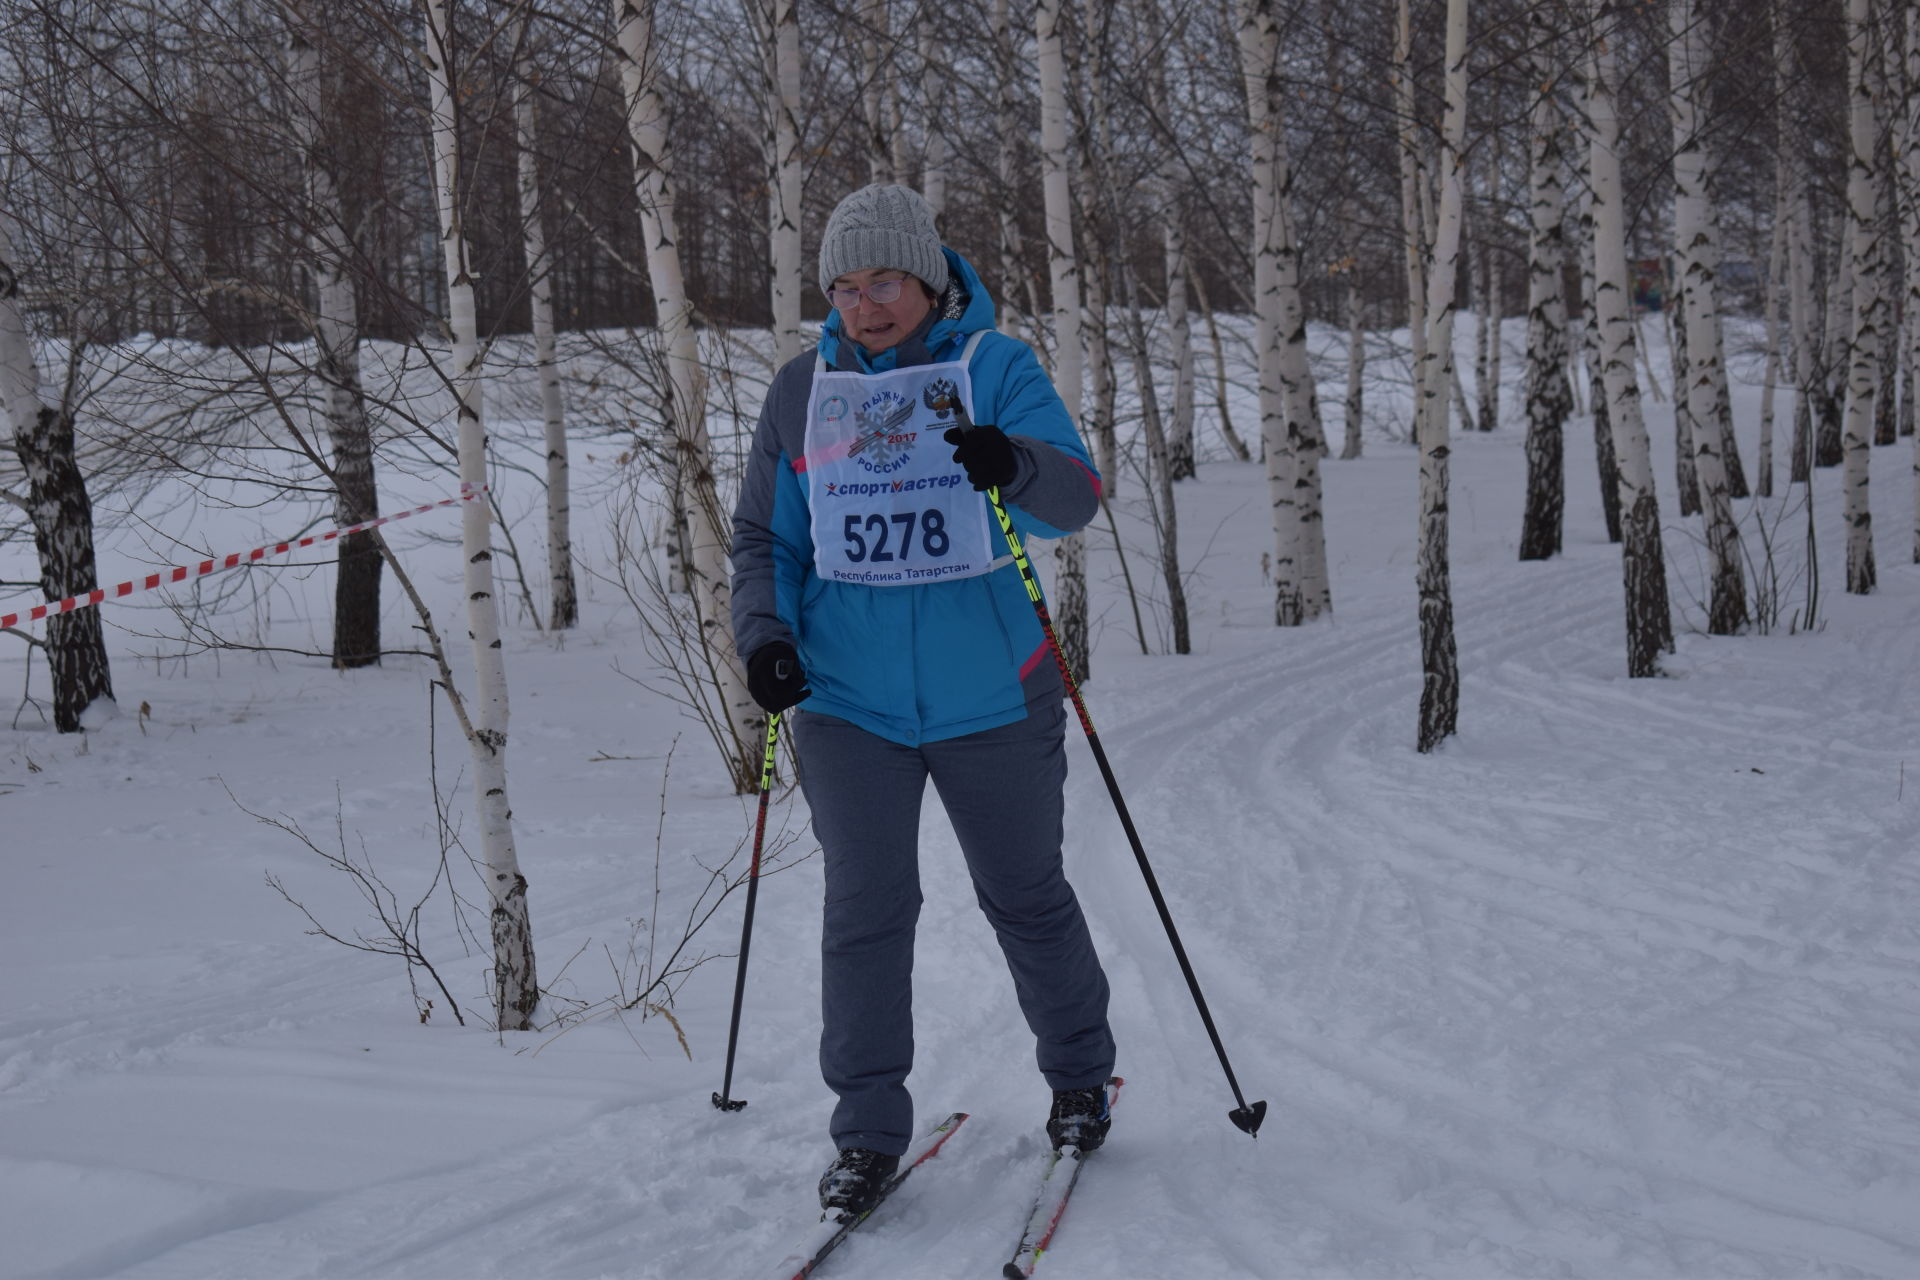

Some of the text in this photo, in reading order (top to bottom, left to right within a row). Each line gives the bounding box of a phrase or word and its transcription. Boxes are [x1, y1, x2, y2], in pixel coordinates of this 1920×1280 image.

[887, 432, 917, 444] 2017
[857, 452, 910, 474] РОССИИ
[843, 508, 950, 563] 5278
[833, 563, 970, 583] Республика Татарстан
